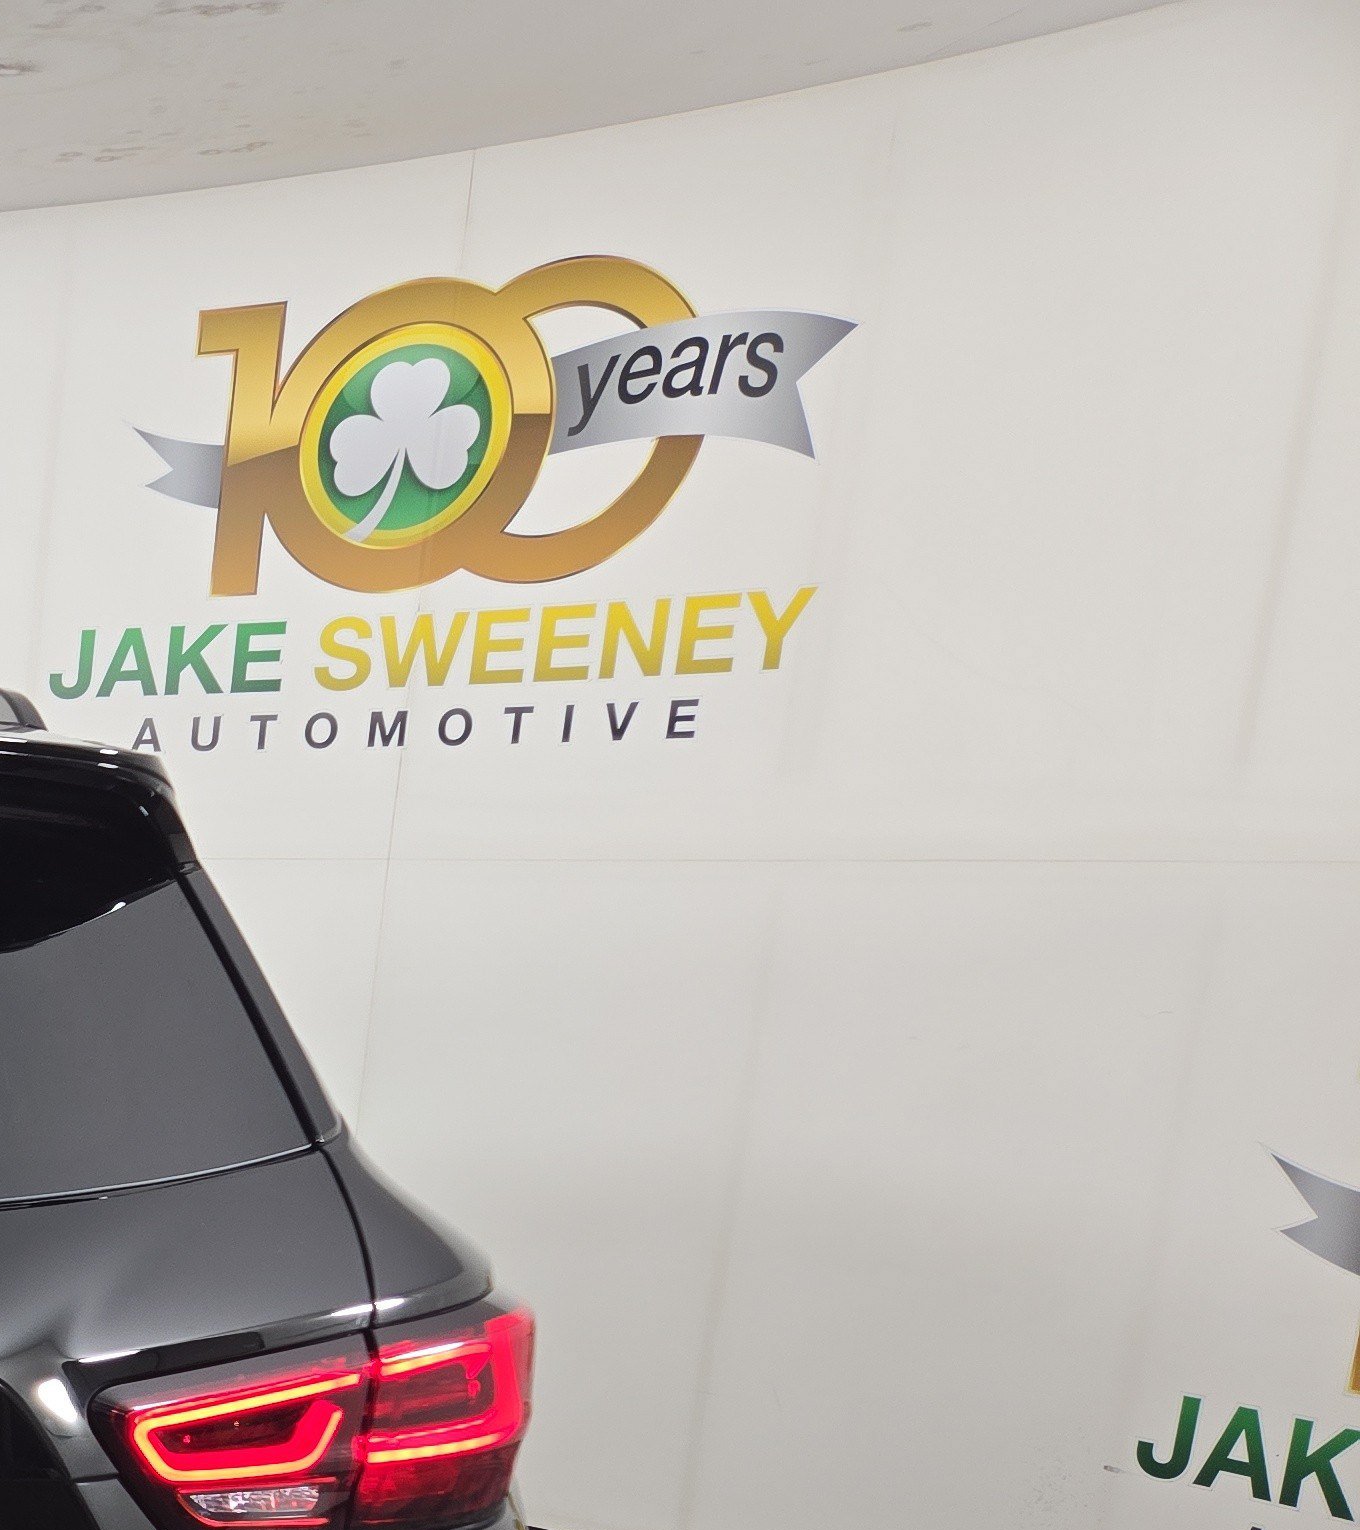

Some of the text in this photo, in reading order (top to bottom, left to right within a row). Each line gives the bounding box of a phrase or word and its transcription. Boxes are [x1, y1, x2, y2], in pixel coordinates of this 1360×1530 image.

[197, 254, 707, 598] 100
[567, 329, 785, 437] years
[48, 586, 819, 700] JAKE SWEENEY
[132, 699, 701, 753] AUTOMOTIVE
